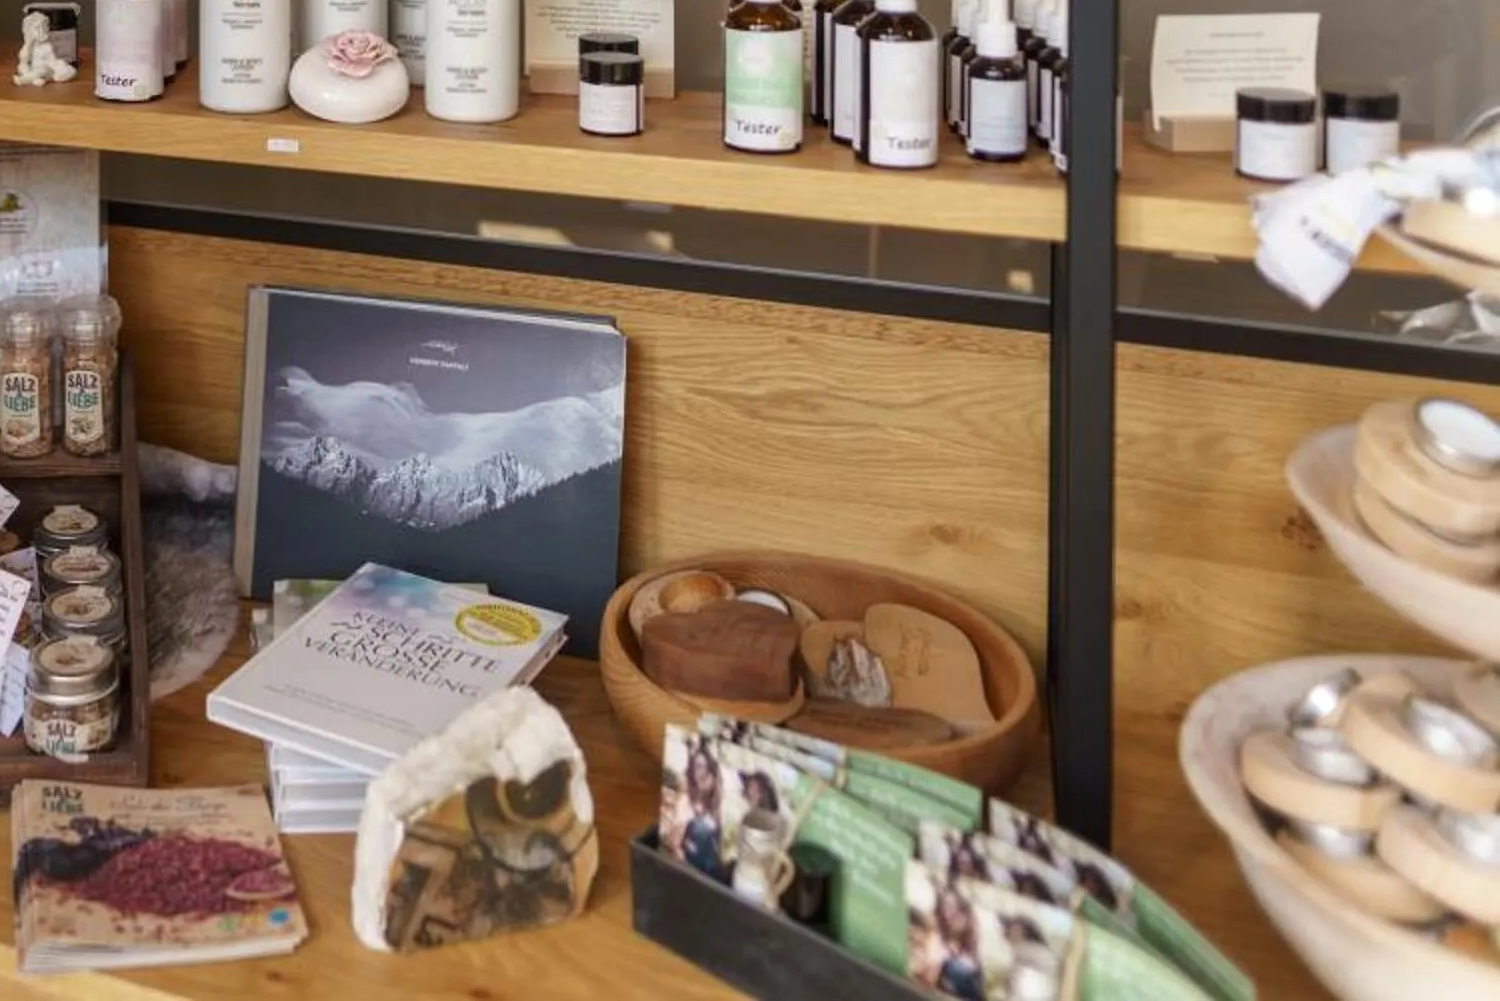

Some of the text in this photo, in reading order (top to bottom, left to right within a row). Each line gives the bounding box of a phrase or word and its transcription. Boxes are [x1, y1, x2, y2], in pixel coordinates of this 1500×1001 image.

[100, 73, 137, 88] Tester
[735, 119, 782, 135] Tester
[887, 137, 933, 150] Tester
[5, 376, 36, 392] SALZ
[67, 373, 98, 389] SALZ
[4, 394, 37, 411] LIEBE
[330, 632, 446, 672] GROSSE
[371, 626, 499, 673] SCHRITTE
